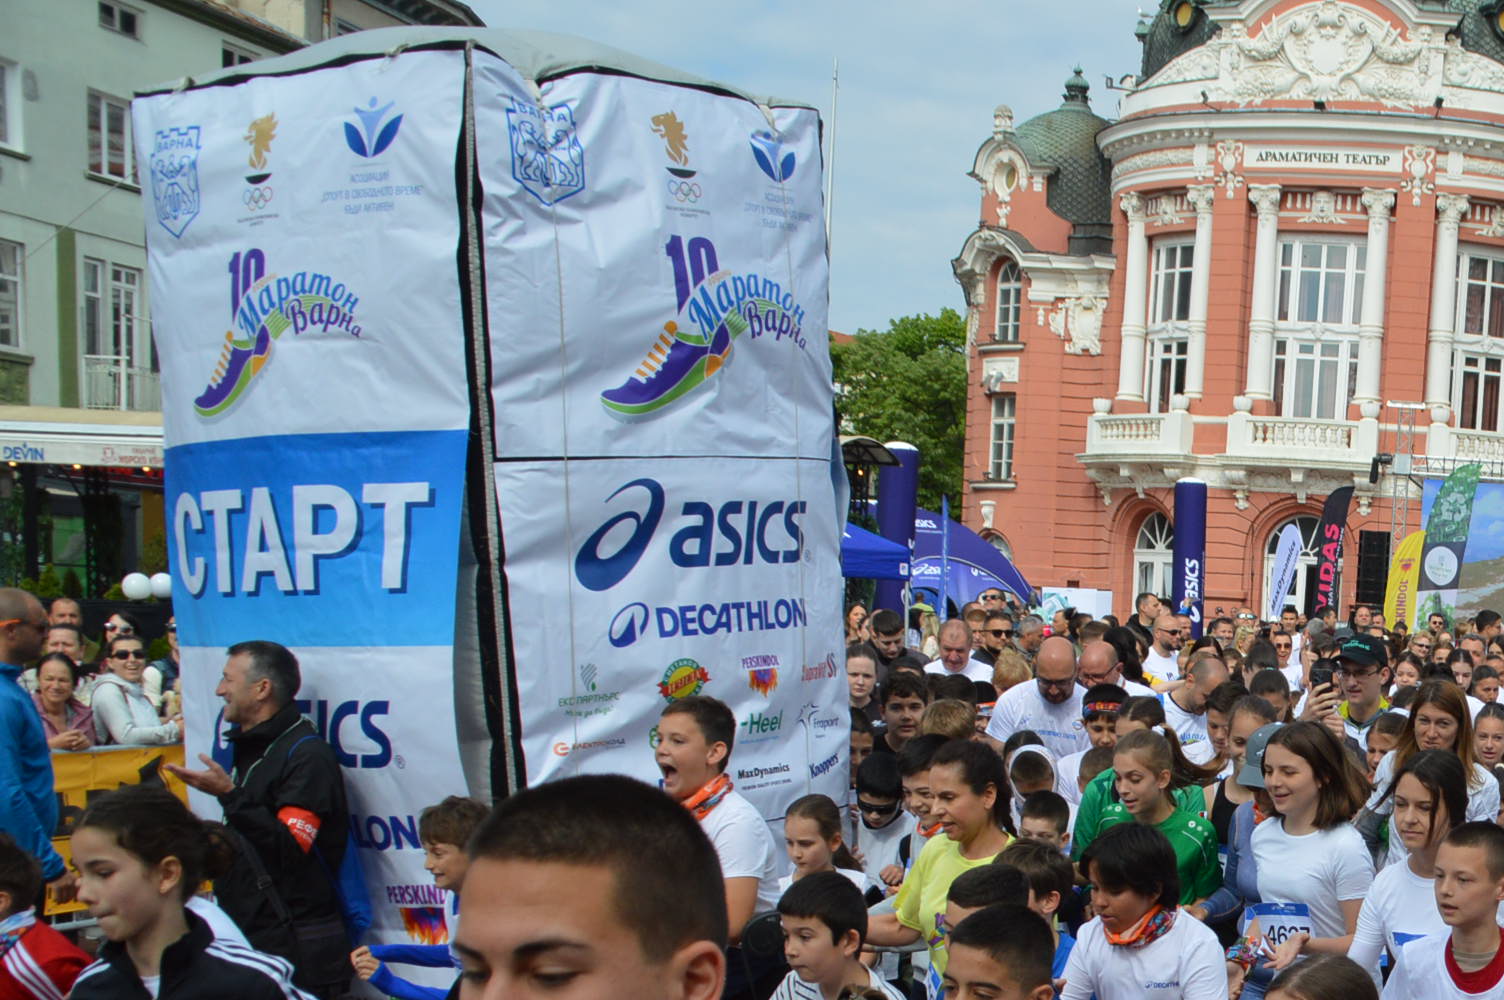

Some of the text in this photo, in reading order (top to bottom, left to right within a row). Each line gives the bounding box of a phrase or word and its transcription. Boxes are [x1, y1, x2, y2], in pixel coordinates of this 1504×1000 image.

[1256, 151, 1391, 167] ДРАМАТИЧЕН ТЕАТЪР
[228, 248, 265, 322] 10
[665, 233, 719, 316] 10
[237, 271, 360, 338] Маратон
[285, 298, 362, 338] Варна
[688, 273, 806, 340] Маратон
[743, 300, 808, 350] Варна
[3, 446, 45, 461] DEVIN
[174, 481, 435, 597] СТАРТ
[655, 598, 807, 639] DECATHLON
[741, 654, 781, 669] PERSKINDOL
[737, 762, 790, 780] MaxDynamics
[808, 752, 840, 781] Knoppers
[387, 884, 447, 905] PERSKIND
